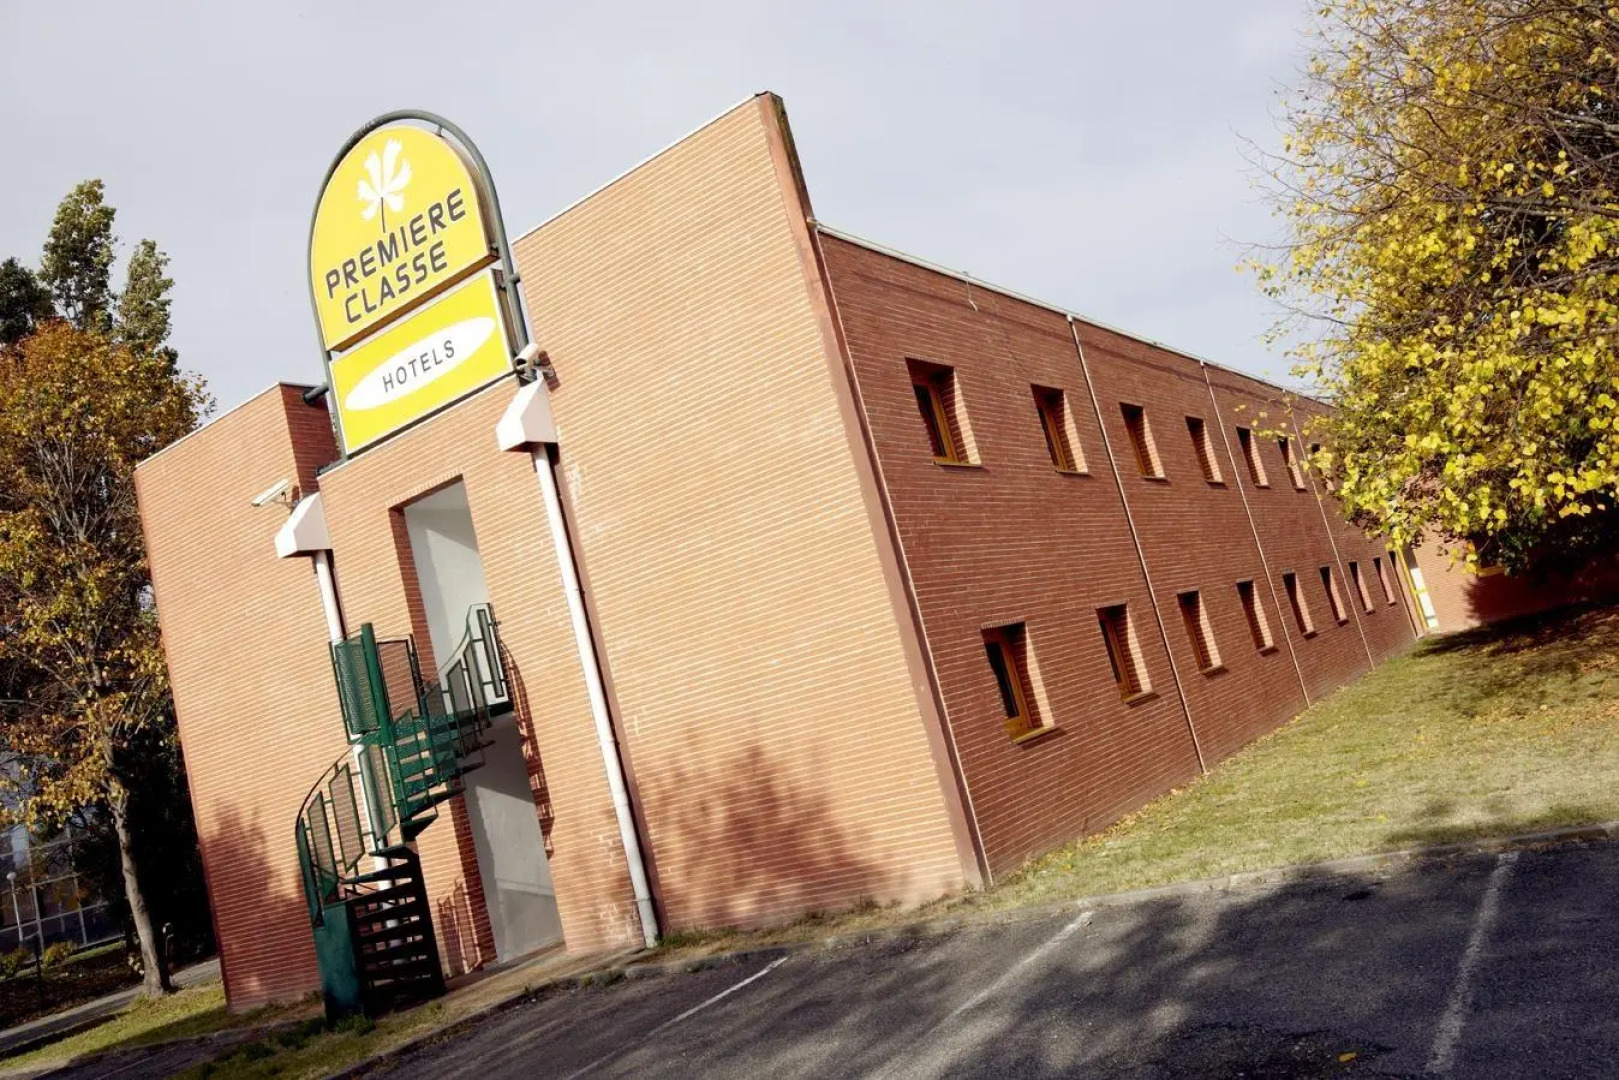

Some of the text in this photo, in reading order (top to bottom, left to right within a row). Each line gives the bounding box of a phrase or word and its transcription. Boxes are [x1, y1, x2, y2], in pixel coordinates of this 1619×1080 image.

[325, 188, 466, 299] PREMIERE
[345, 241, 447, 324] CLASSE
[382, 340, 455, 393] HOTELS
